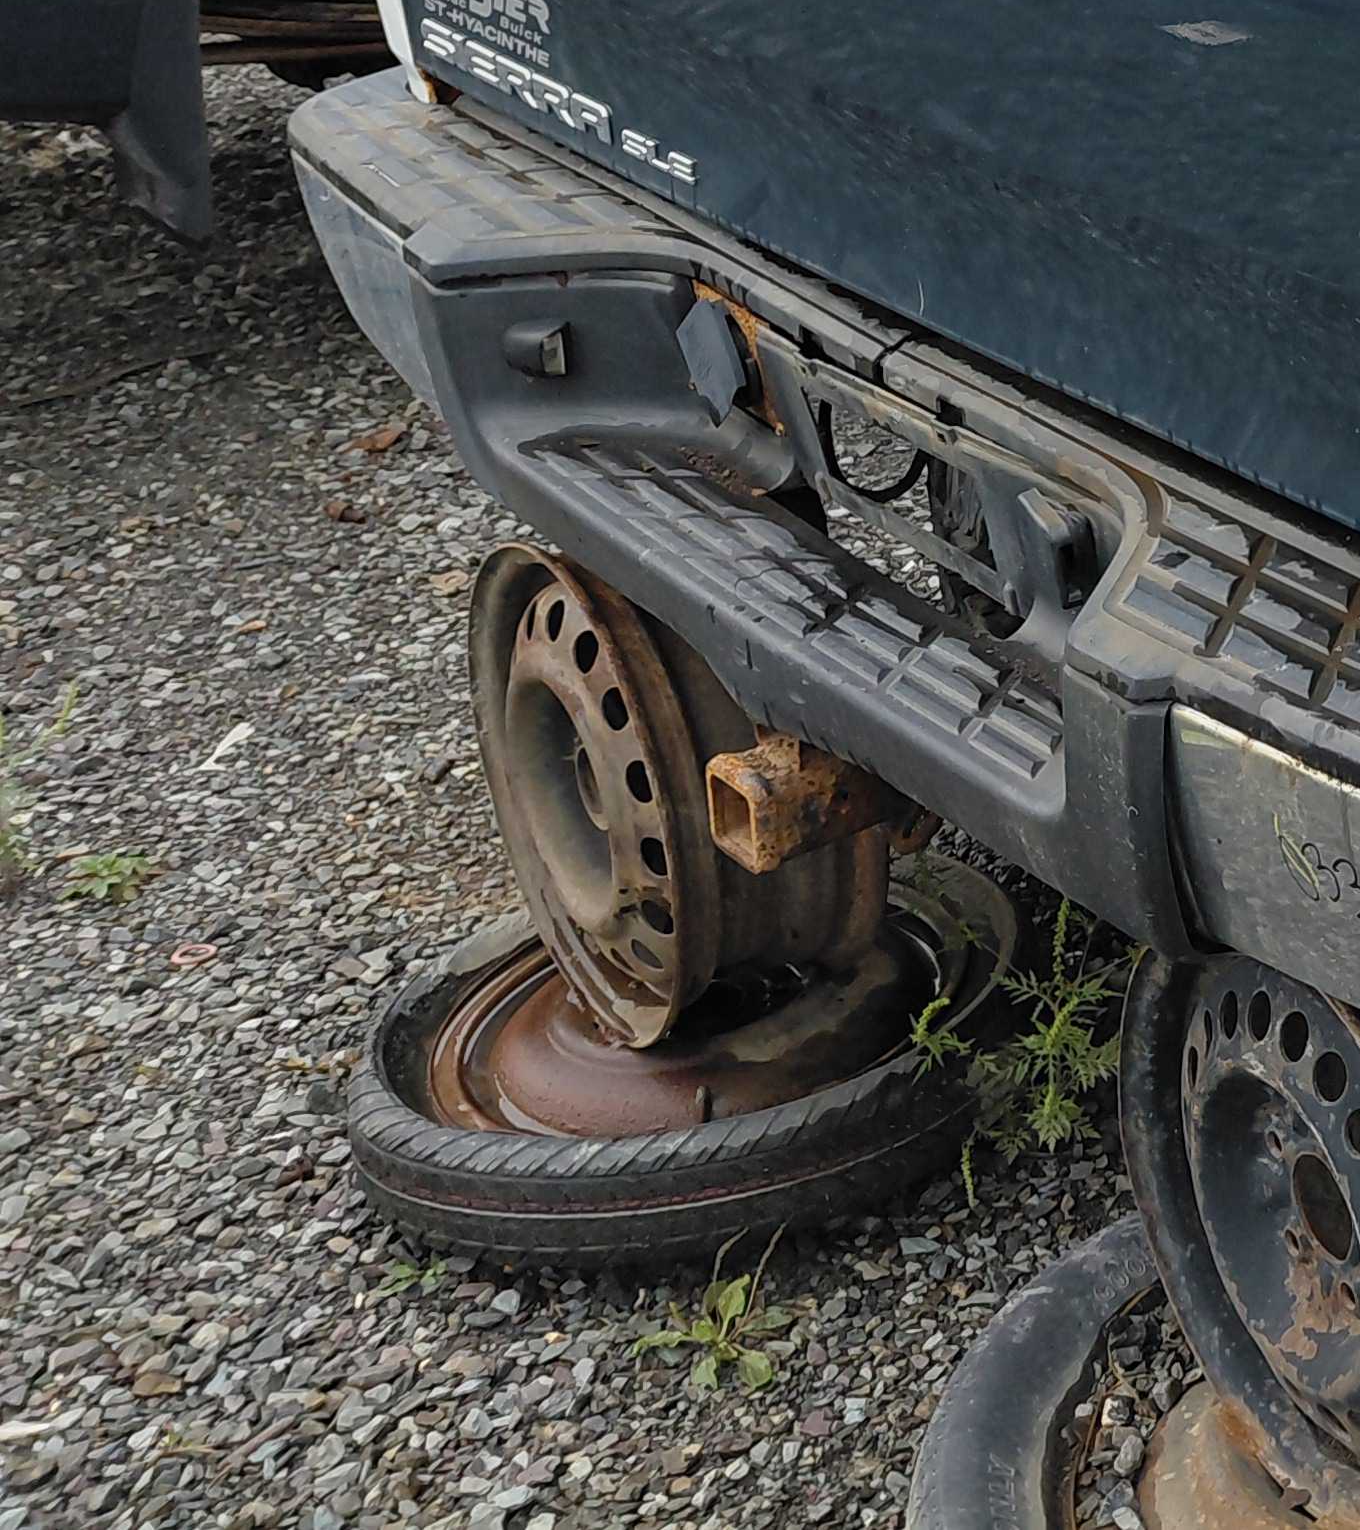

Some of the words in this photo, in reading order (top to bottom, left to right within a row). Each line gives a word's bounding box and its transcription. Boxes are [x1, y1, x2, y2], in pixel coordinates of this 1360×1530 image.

[500, 18, 543, 44] Buick
[420, 18, 614, 145] SIERRA
[621, 128, 699, 185] SLE
